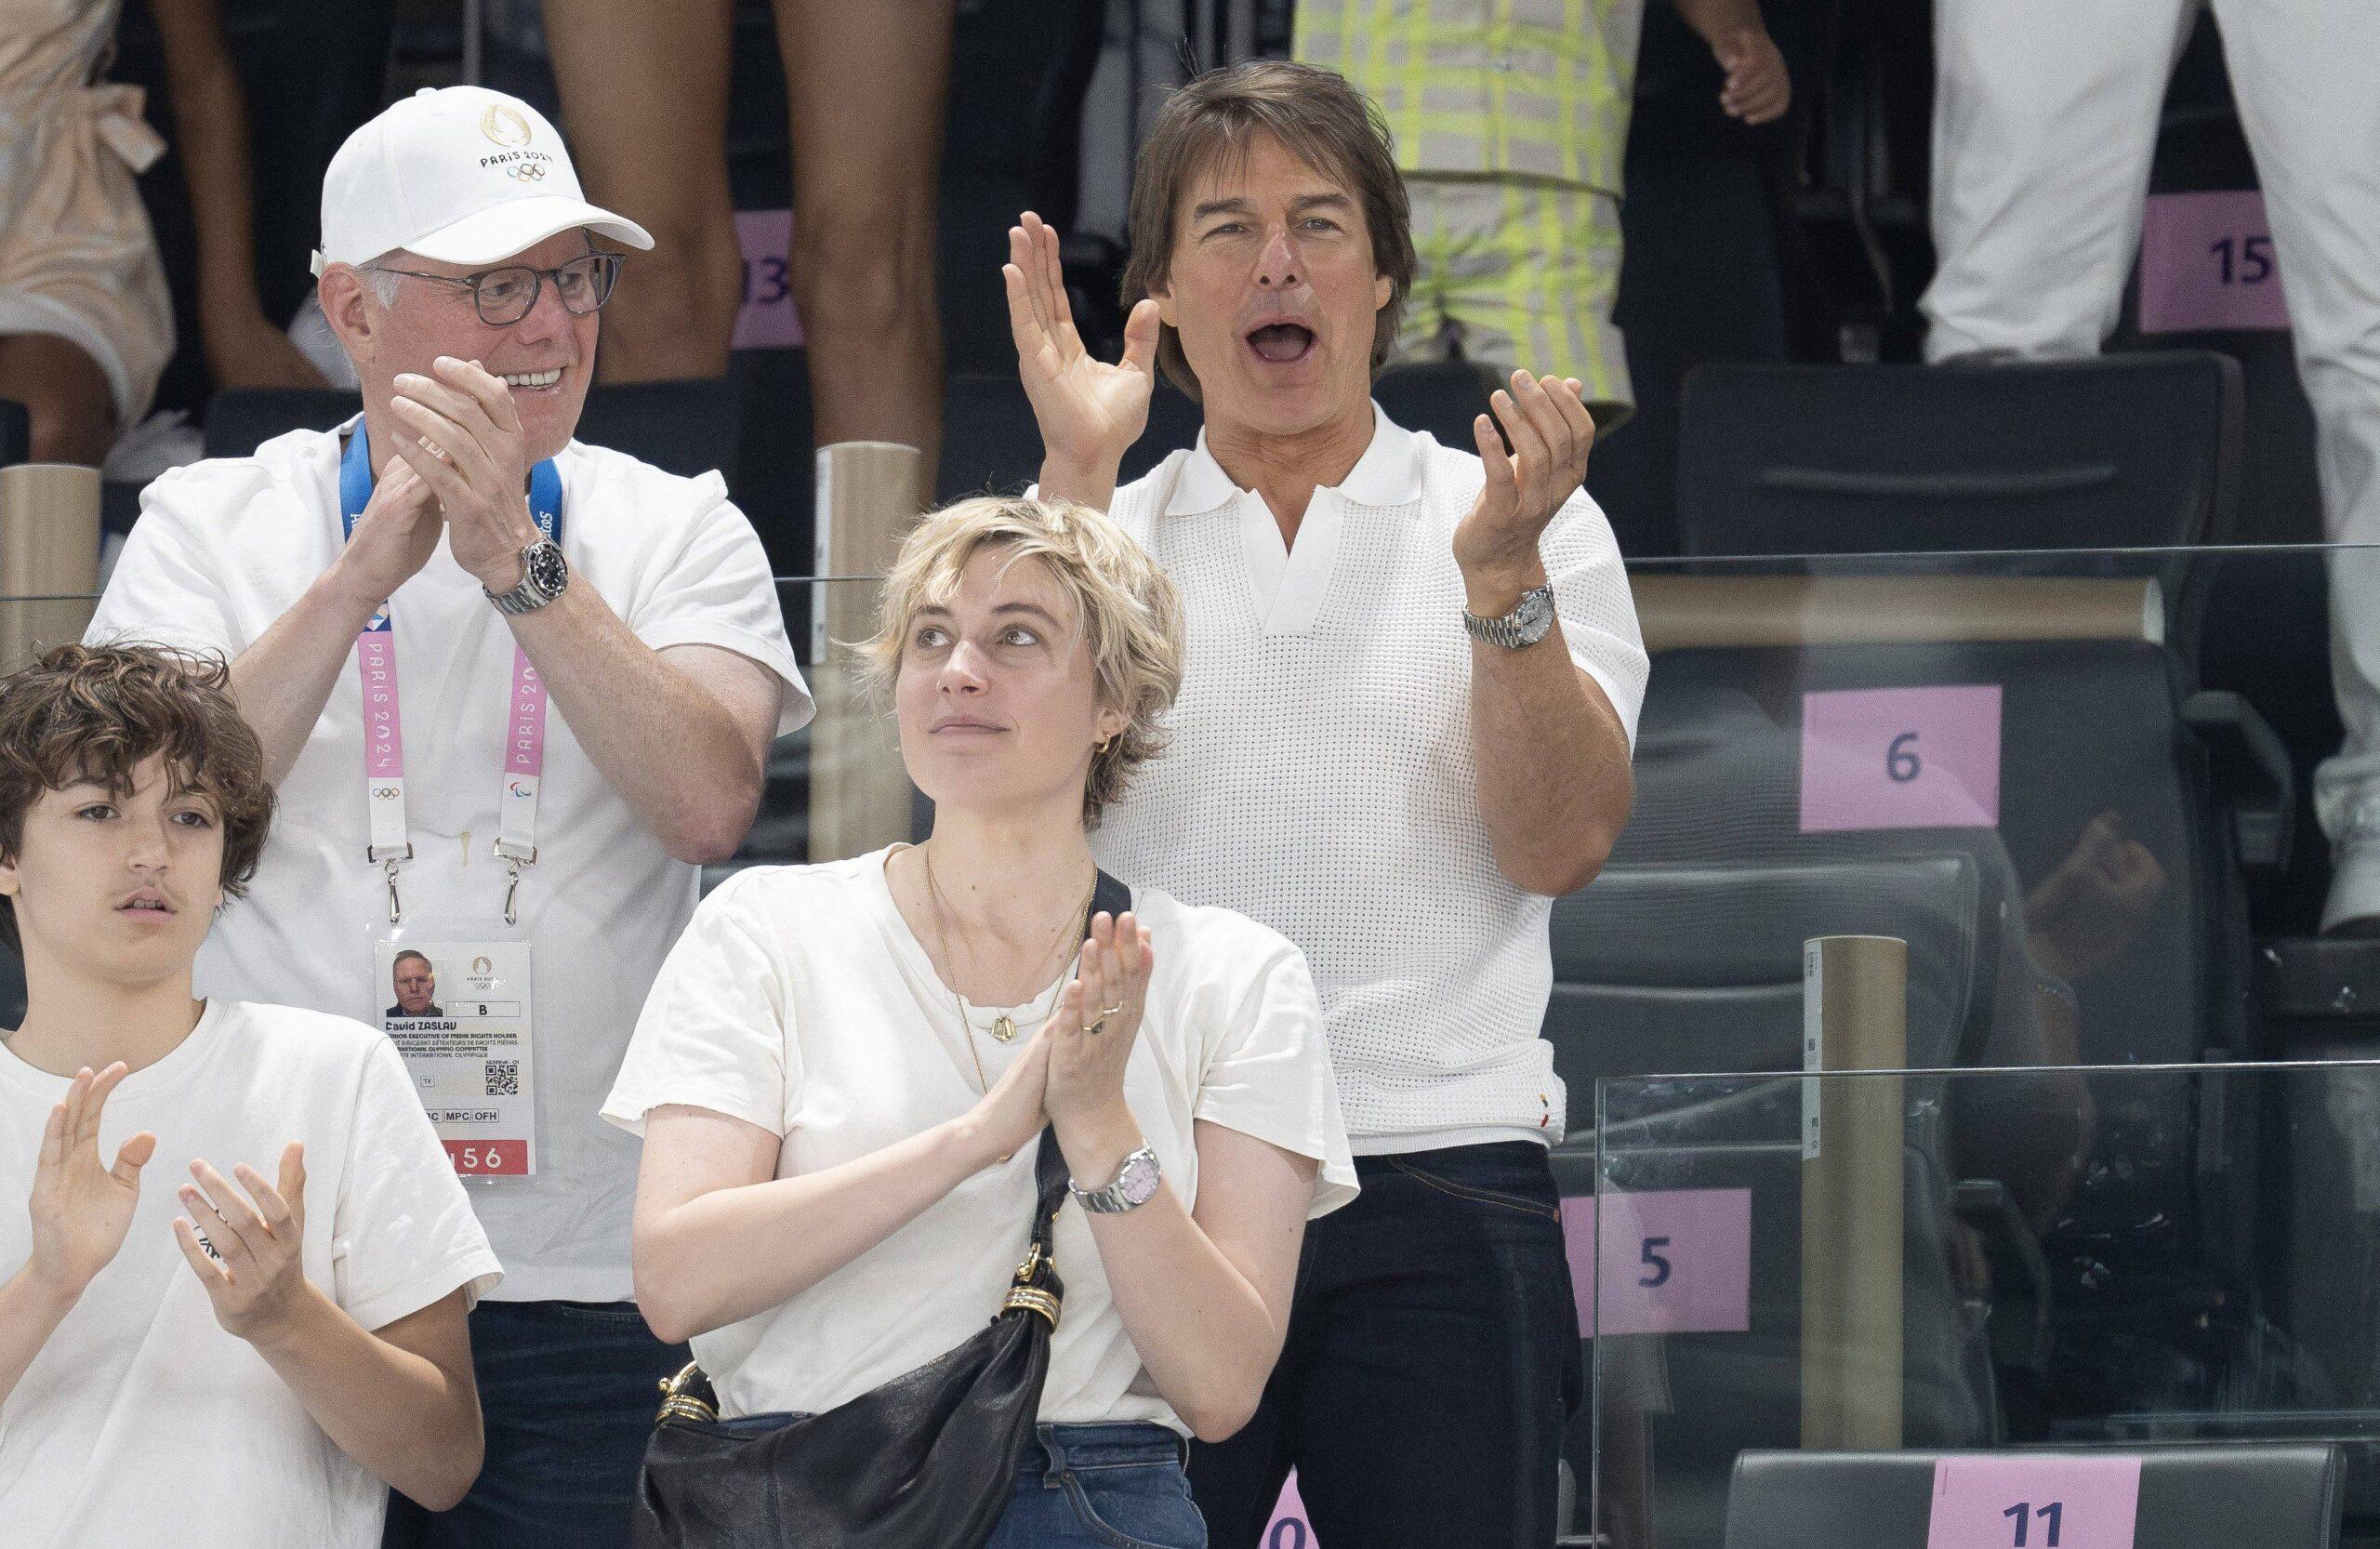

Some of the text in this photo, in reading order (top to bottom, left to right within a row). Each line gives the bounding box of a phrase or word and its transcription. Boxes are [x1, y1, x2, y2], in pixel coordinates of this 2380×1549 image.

[2211, 235, 2271, 285] 15
[368, 642, 392, 768] PARIS 2024
[516, 656, 537, 764] PARIS 20
[1886, 731, 1921, 783] 6
[479, 1004, 488, 1015] B
[446, 1112, 469, 1121] MPC
[474, 1111, 496, 1121] OFH
[1638, 1237, 1671, 1288] 5
[2003, 1503, 2062, 1547] 11
